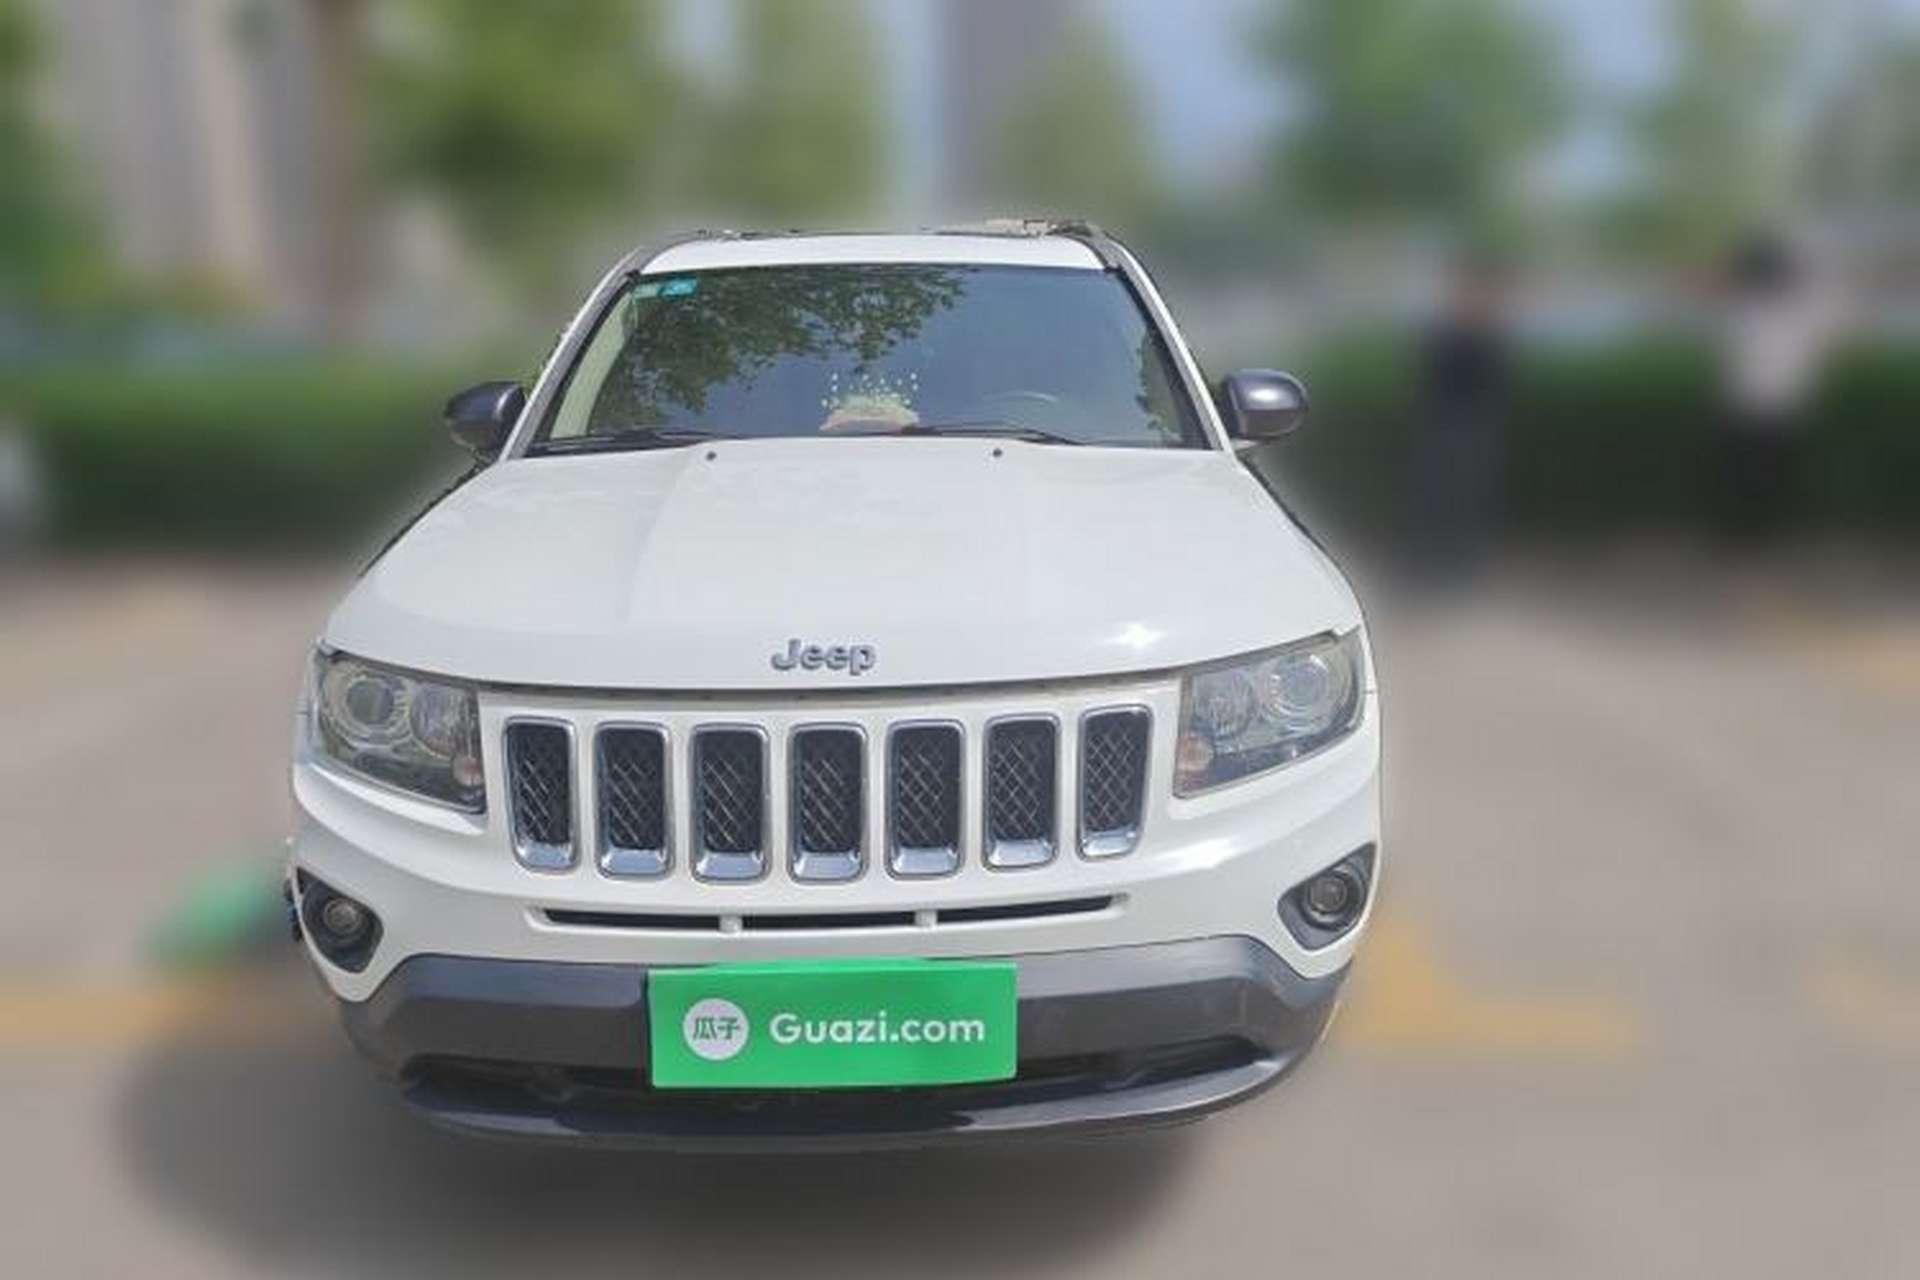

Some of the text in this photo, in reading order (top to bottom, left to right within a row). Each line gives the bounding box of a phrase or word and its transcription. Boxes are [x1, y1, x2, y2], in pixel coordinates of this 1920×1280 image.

[771, 638, 876, 676] Jeep
[692, 1017, 741, 1041] 瓜子
[769, 1010, 985, 1044] Guazi.com
